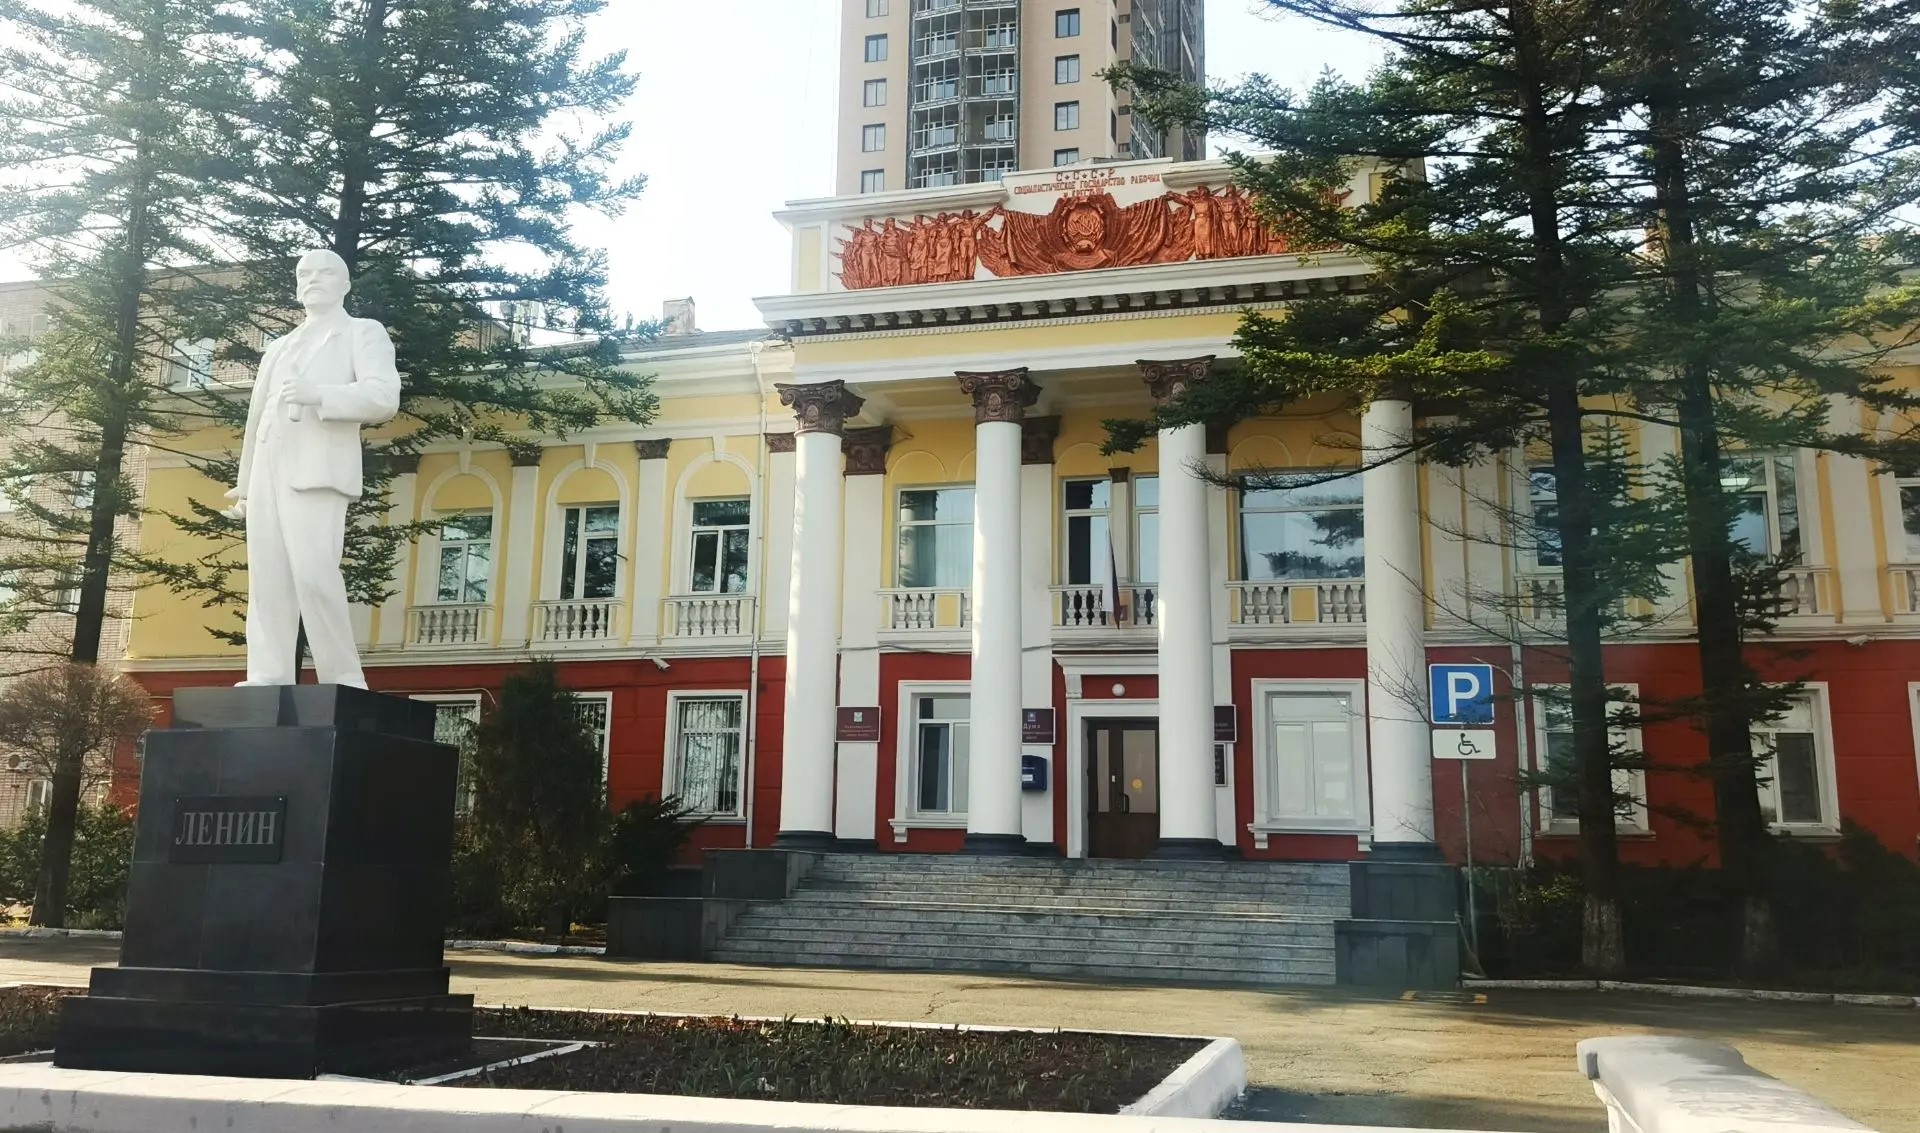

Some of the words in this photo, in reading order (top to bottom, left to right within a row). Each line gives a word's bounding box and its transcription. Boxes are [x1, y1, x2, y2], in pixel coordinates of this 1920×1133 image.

[1014, 181, 1076, 195] СОЦИАЛИСТИЧЕСКОЕ
[1080, 176, 1125, 189] ГОСУДАРСТВО
[1130, 173, 1161, 185] РАБОЧИХ
[1447, 671, 1480, 718] P
[175, 811, 279, 845] ЛЕНИН
